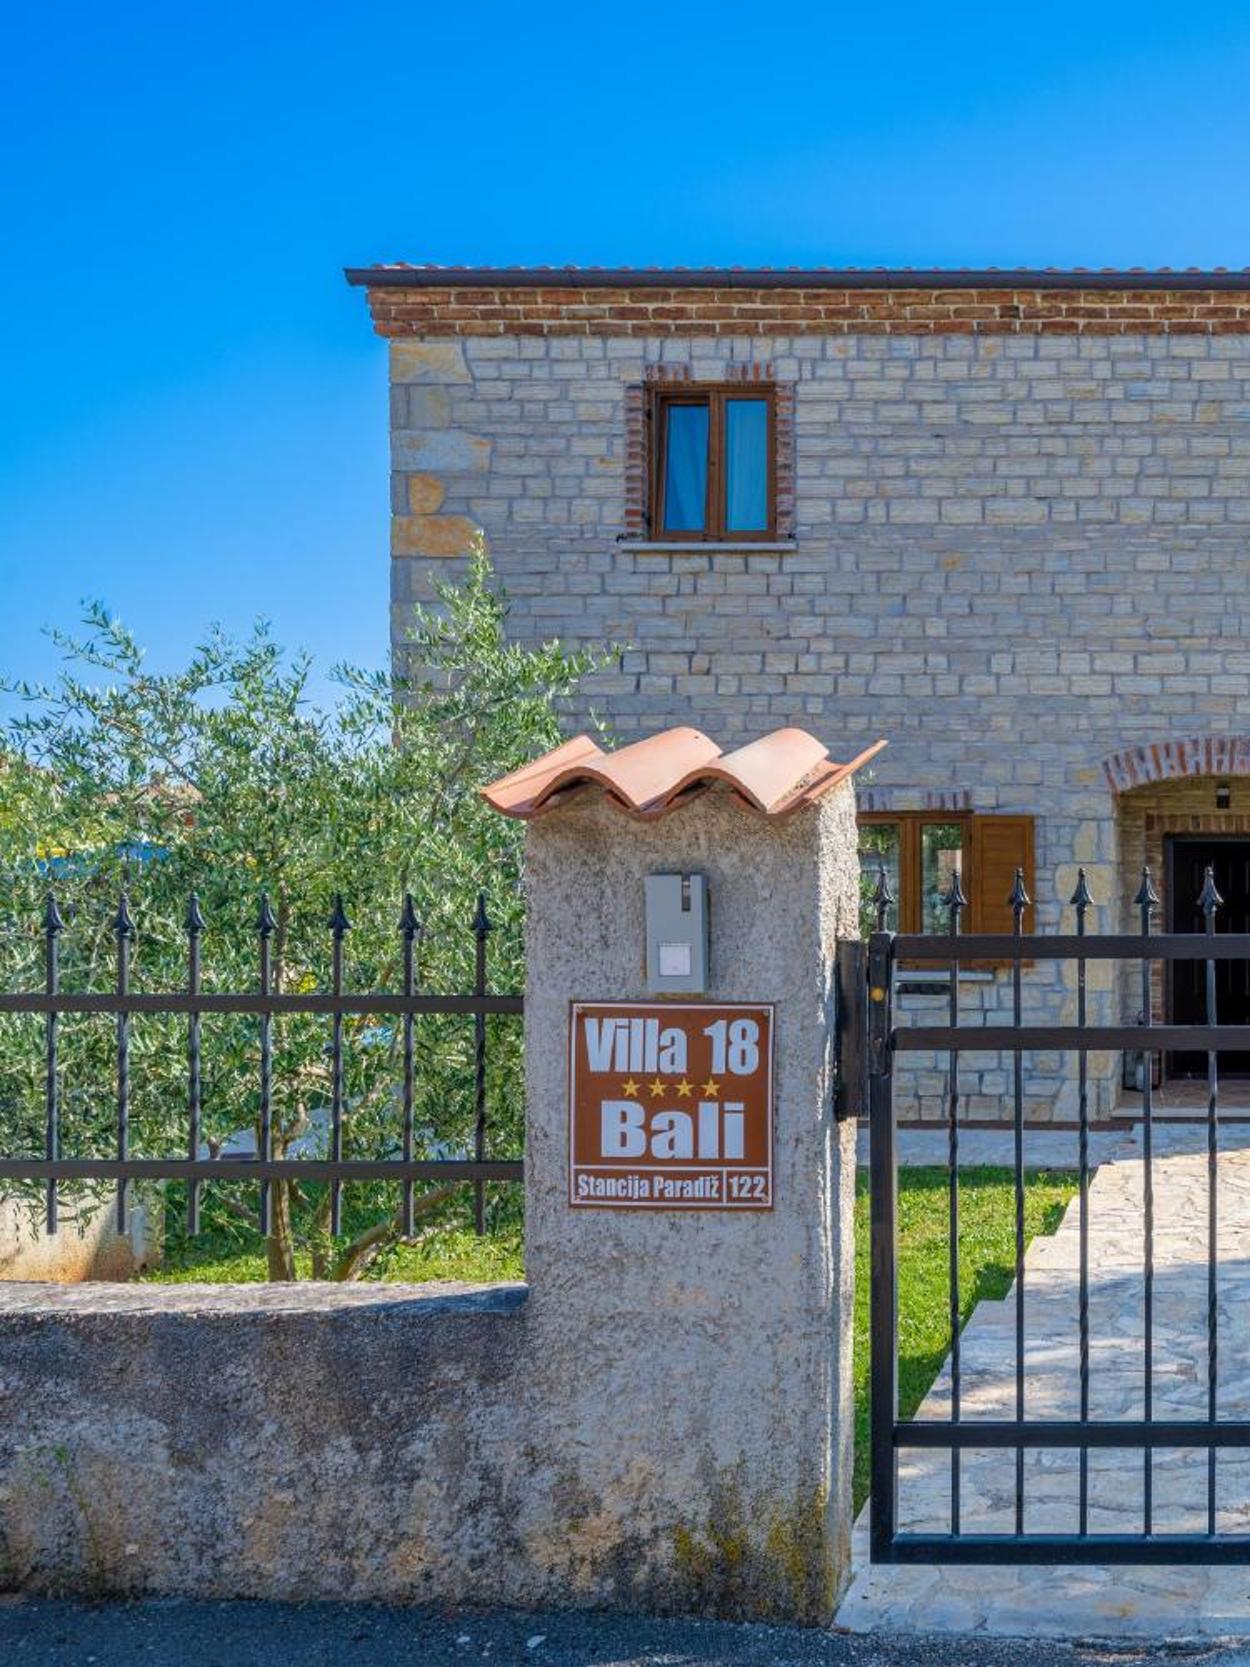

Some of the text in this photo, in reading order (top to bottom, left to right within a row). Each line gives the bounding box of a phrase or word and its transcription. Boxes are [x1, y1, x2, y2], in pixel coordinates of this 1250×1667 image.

[584, 1018, 760, 1075] Villa 18
[600, 1100, 744, 1160] Bali
[577, 1174, 650, 1199] Stancija
[729, 1175, 767, 1198] 122
